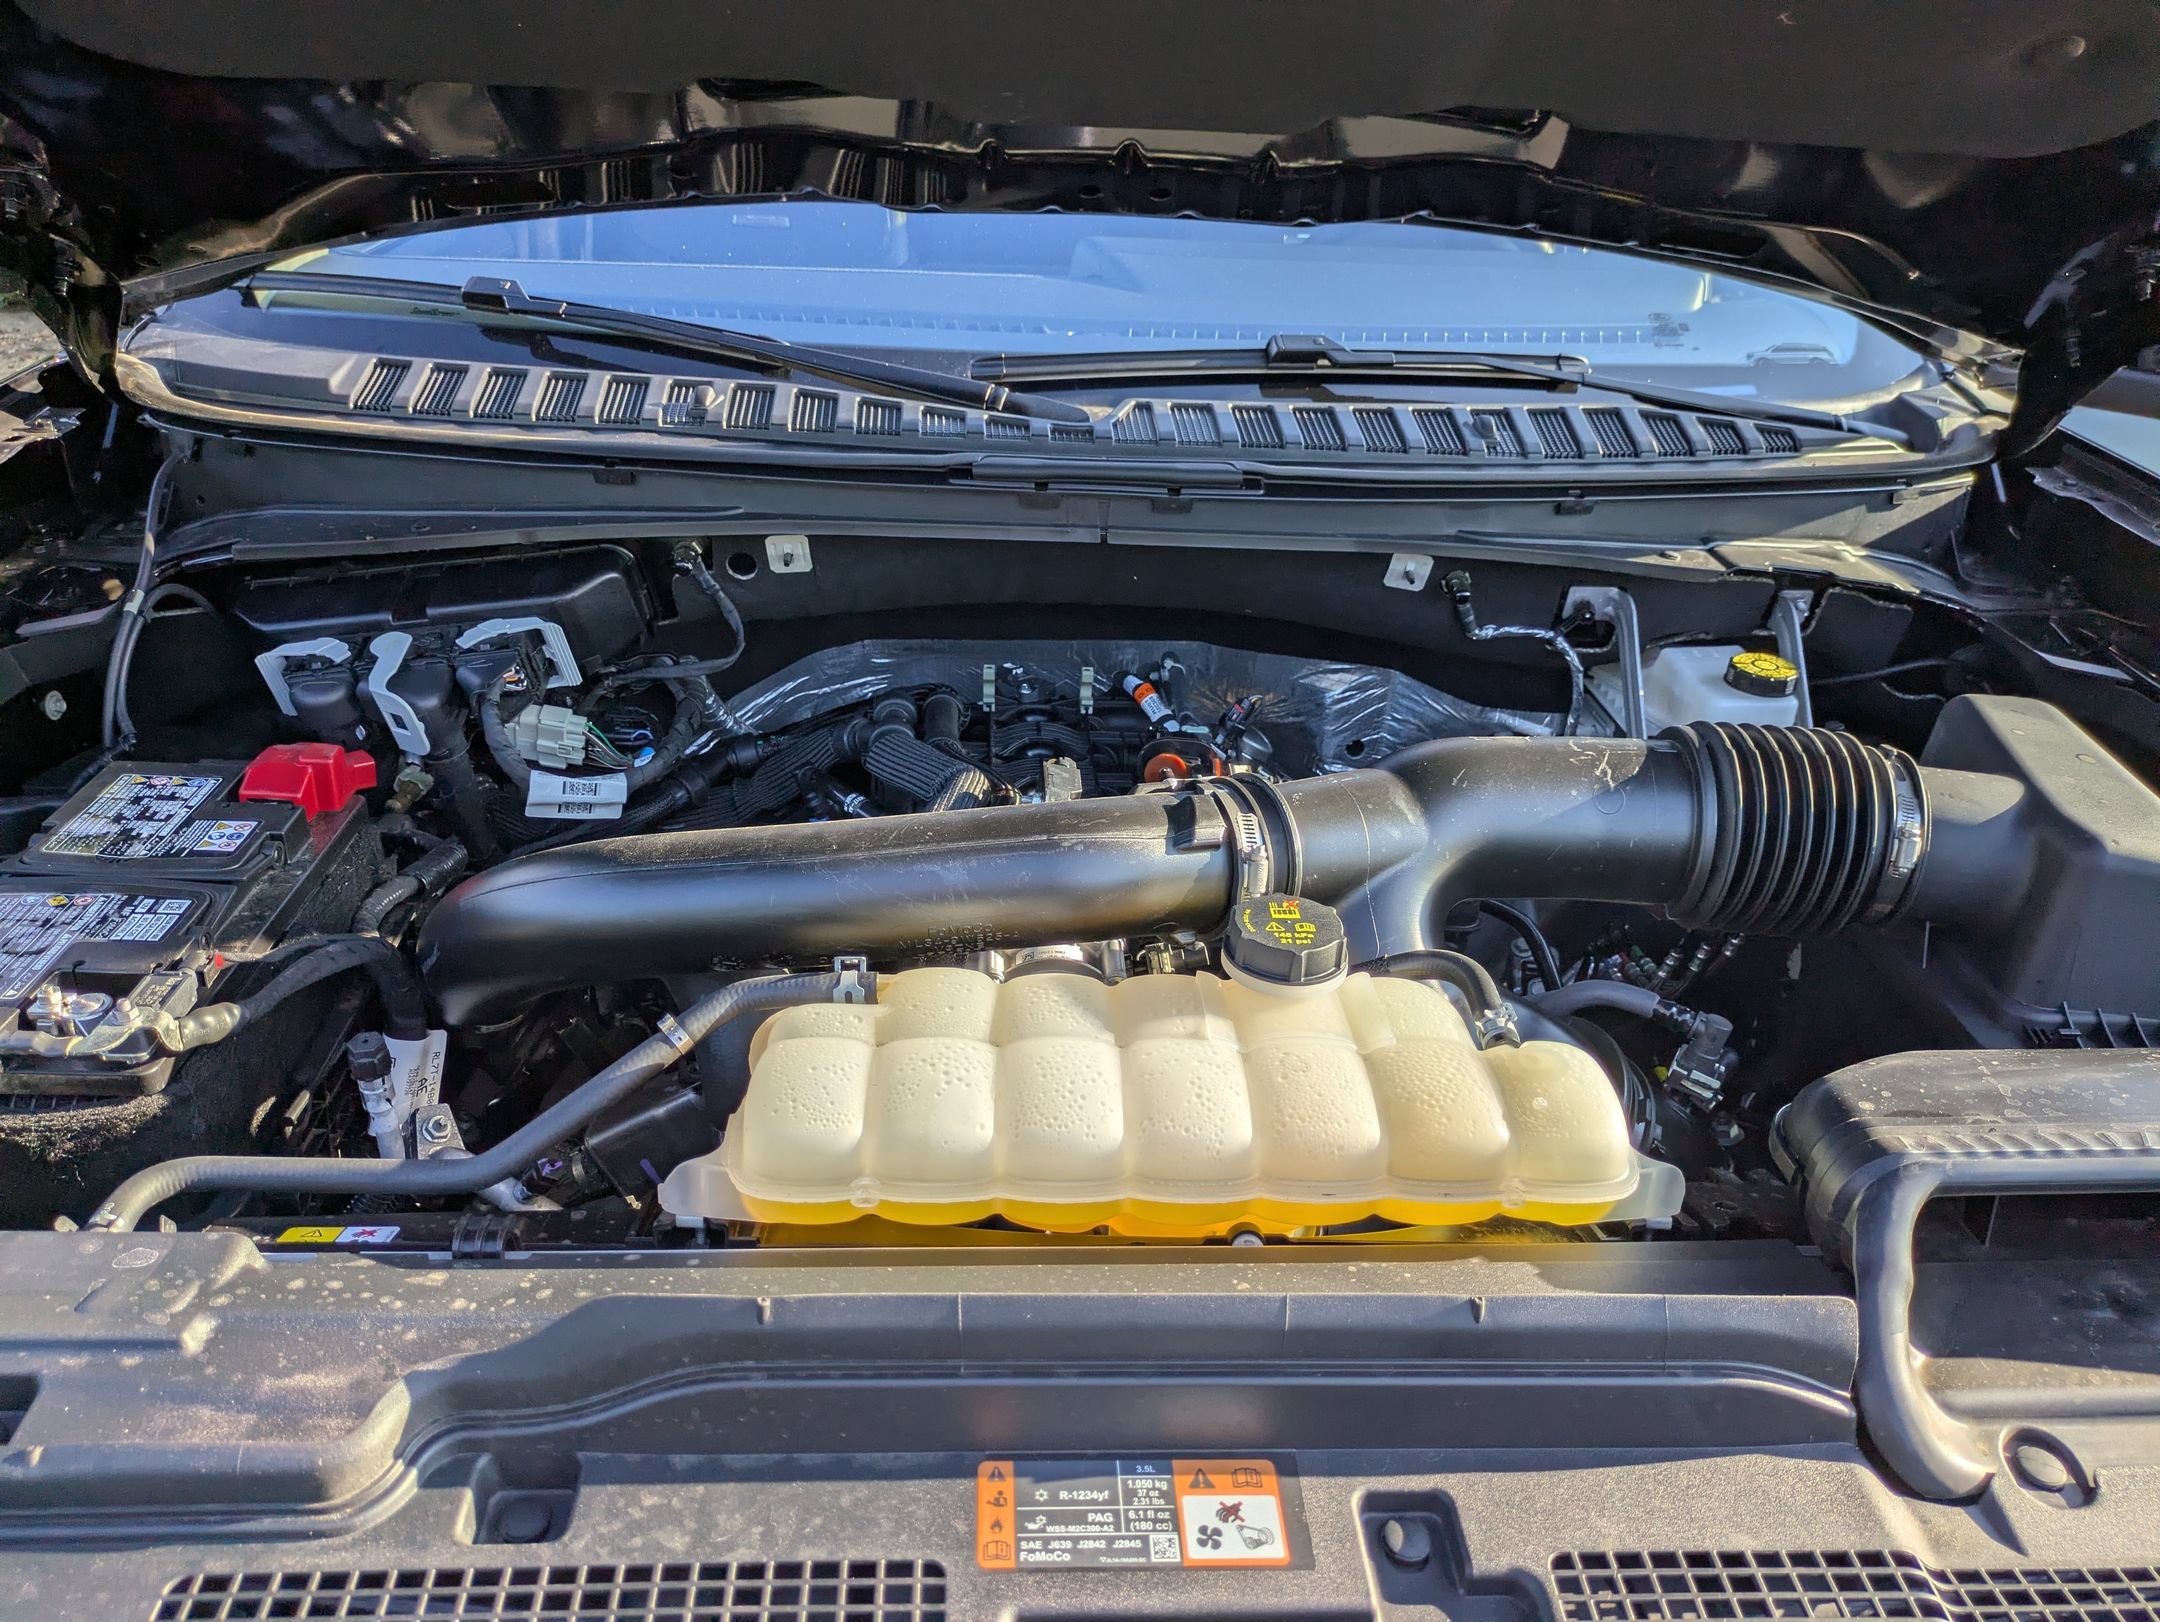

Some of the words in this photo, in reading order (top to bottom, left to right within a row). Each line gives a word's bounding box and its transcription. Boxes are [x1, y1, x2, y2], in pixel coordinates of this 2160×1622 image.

[1135, 1465, 1156, 1473] 3.5L
[1127, 1480, 1153, 1488] 1.050
[1154, 1480, 1168, 1490] kg
[1059, 1490, 1109, 1502] R-1234yf
[1136, 1489, 1147, 1497] 37
[1132, 1497, 1150, 1505] 2.31
[1151, 1497, 1165, 1505] lbs
[1087, 1512, 1113, 1522] PAG
[1128, 1510, 1144, 1519] 6.1
[1146, 1510, 1155, 1518] fl
[1156, 1511, 1171, 1519] oz
[1129, 1521, 1153, 1531] (180
[1155, 1520, 1173, 1531] cc)
[1020, 1540, 1043, 1549] SAE
[1047, 1540, 1072, 1549] J639
[1076, 1540, 1106, 1548] J2842
[1112, 1539, 1142, 1548] J2845
[1019, 1551, 1071, 1561] FoMoCo
